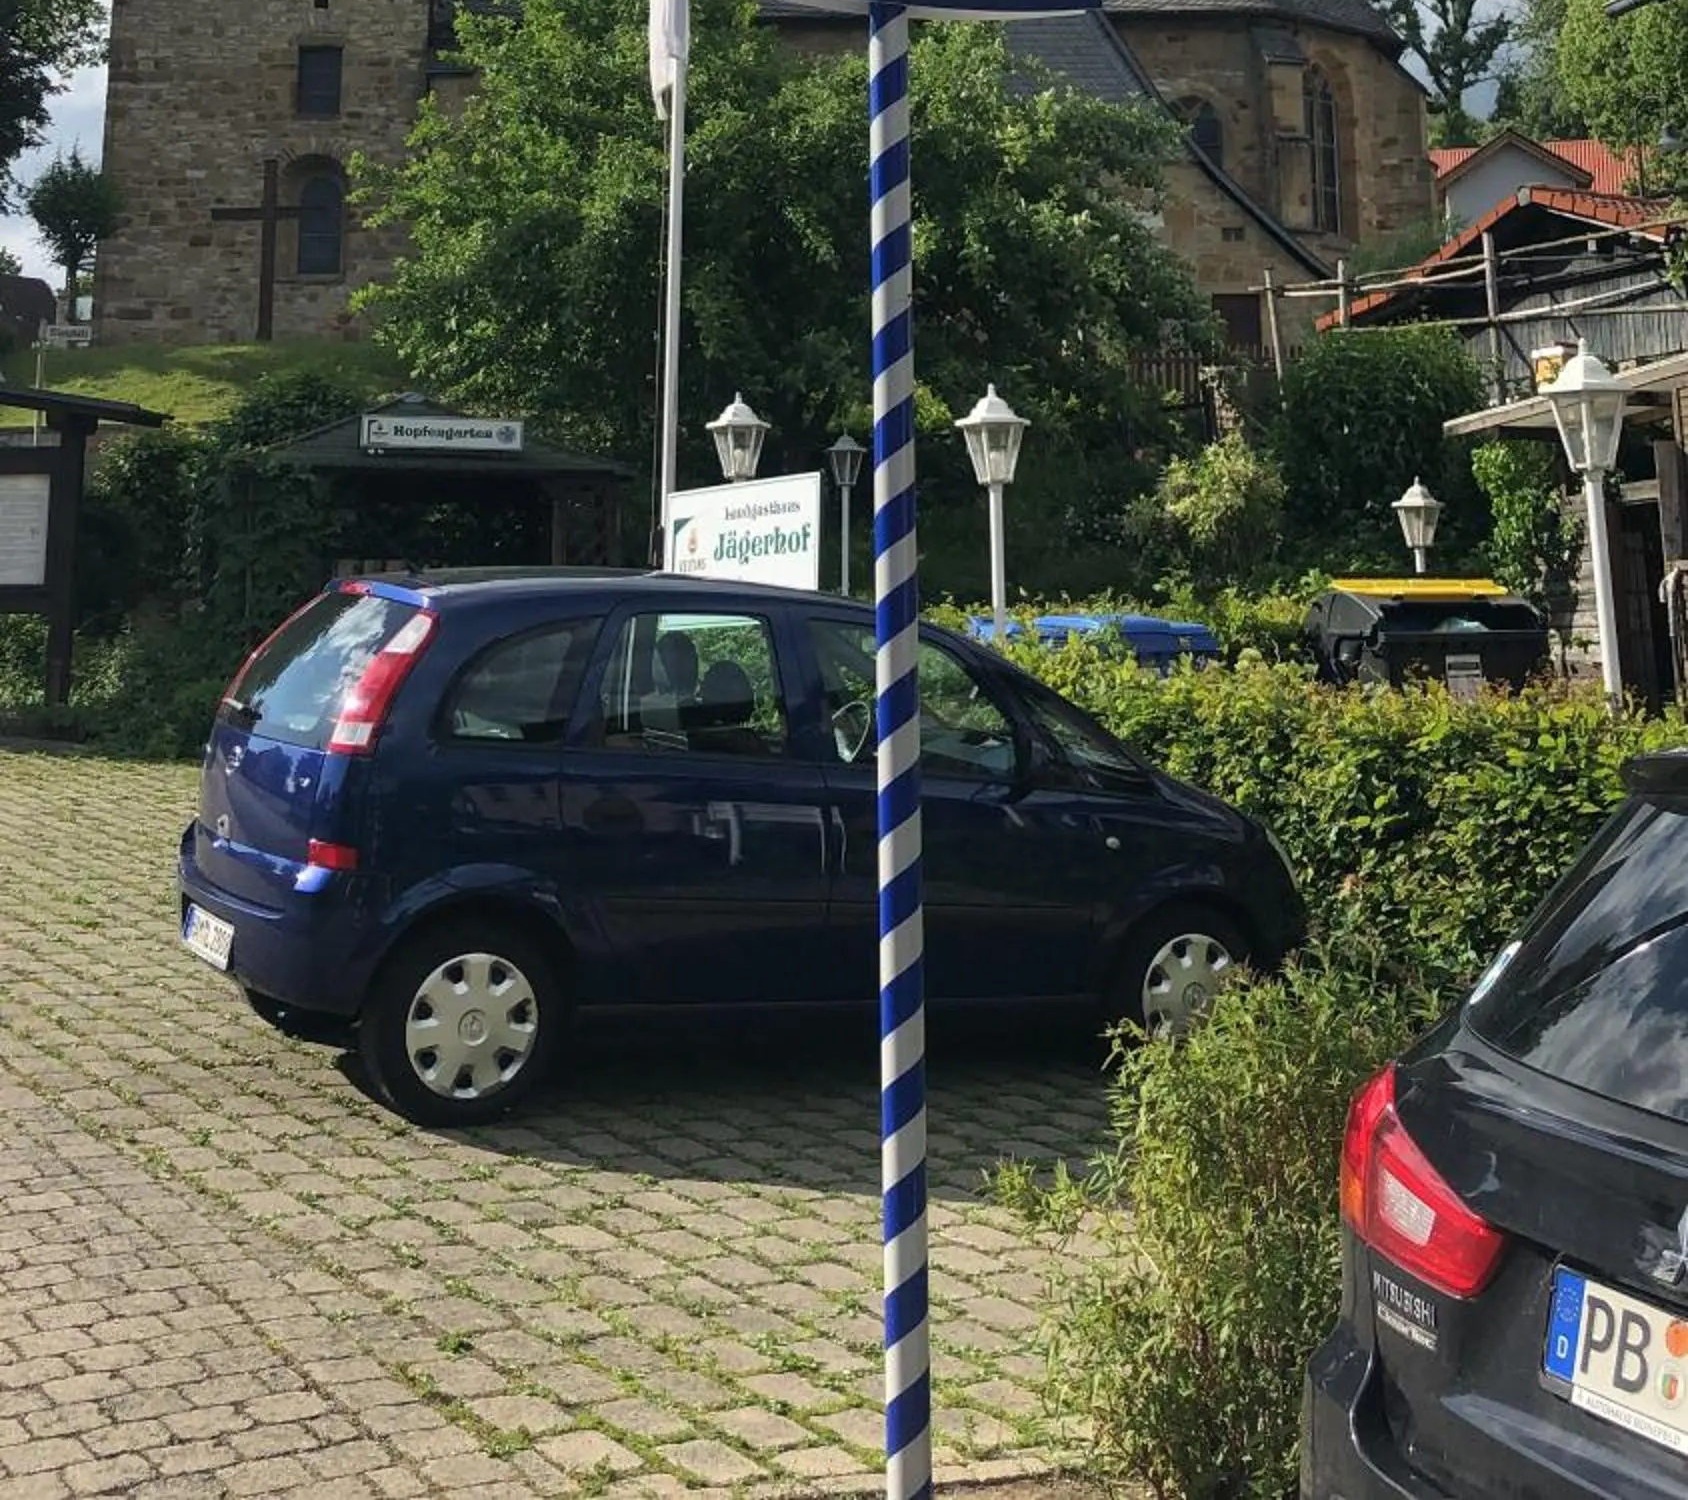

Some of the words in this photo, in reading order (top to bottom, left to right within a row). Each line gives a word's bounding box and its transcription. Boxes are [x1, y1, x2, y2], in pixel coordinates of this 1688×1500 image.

[713, 522, 811, 565] Jägerhof
[1373, 1270, 1435, 1328] MITSUBISHI
[1556, 1335, 1569, 1359] D
[1580, 1295, 1651, 1394] PB
